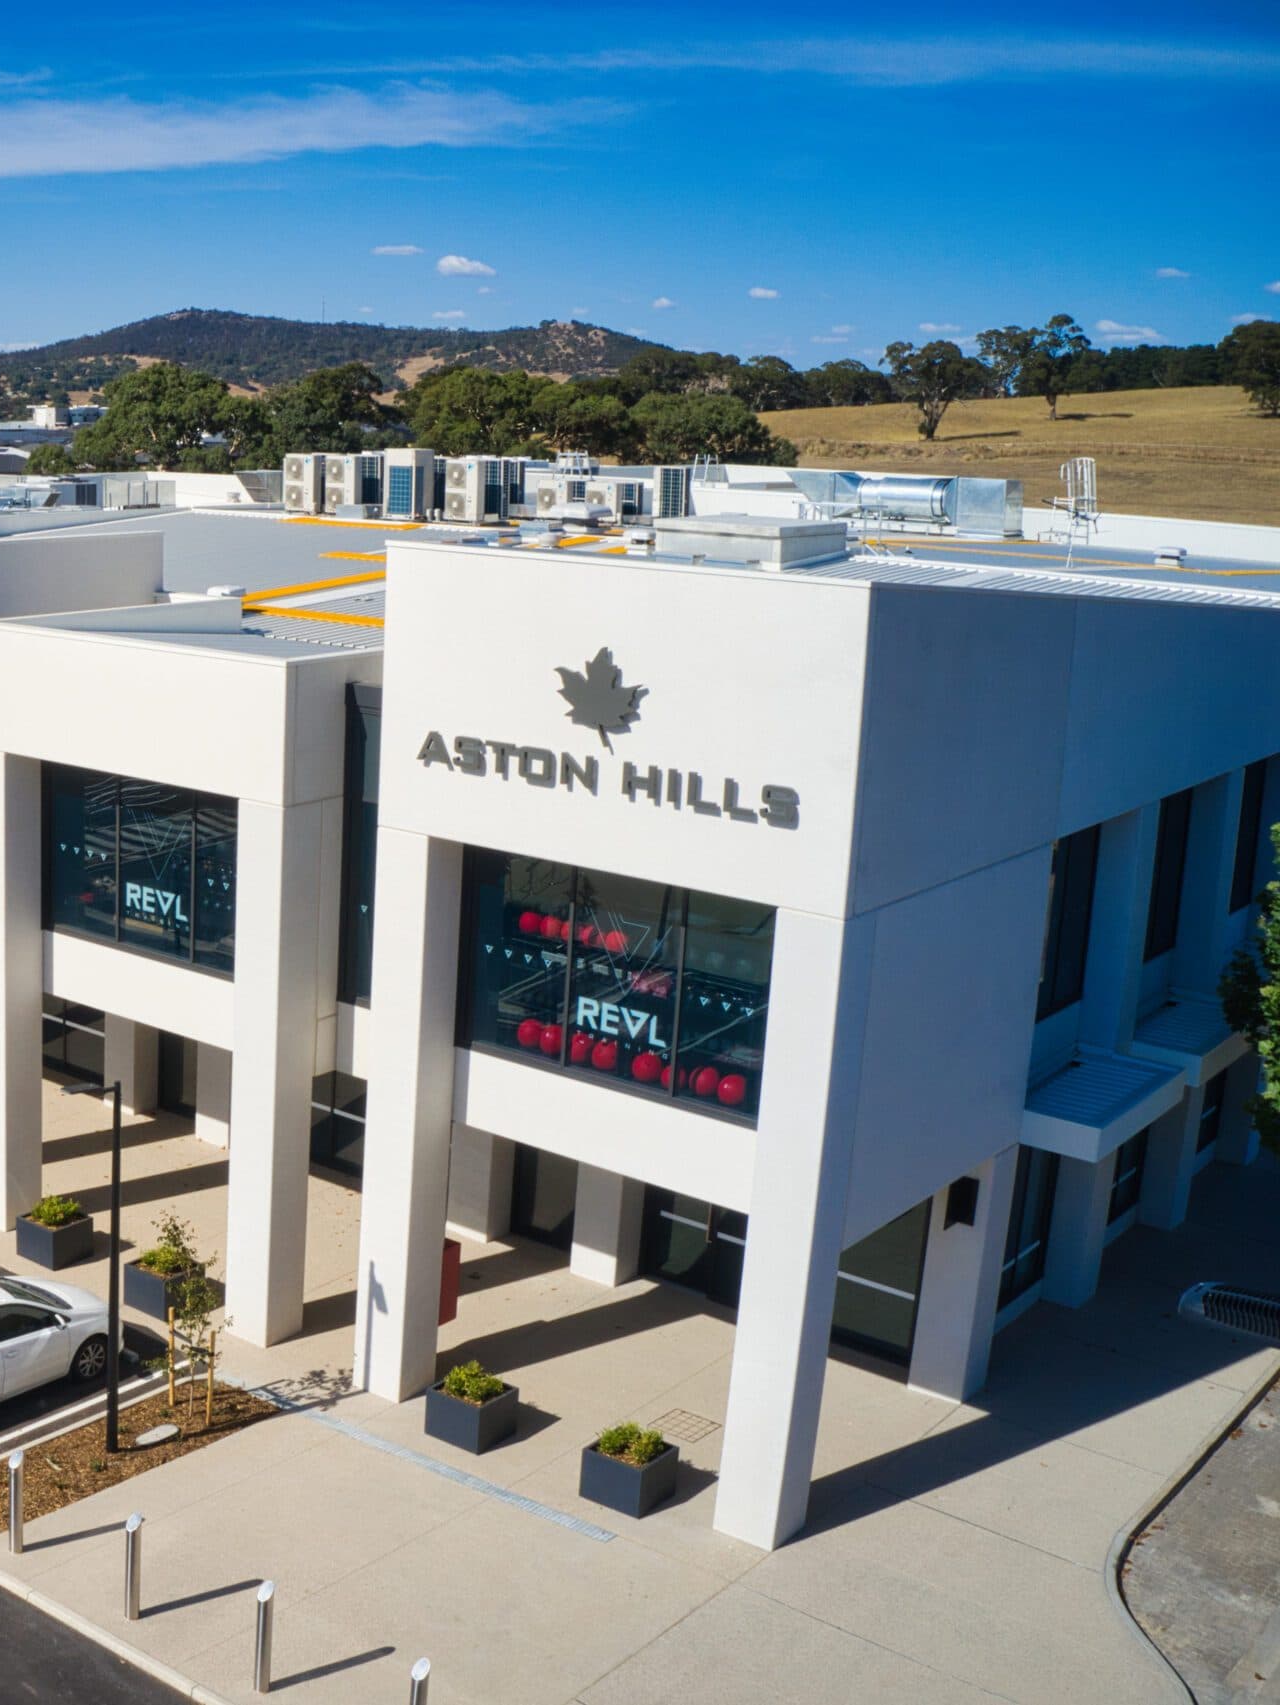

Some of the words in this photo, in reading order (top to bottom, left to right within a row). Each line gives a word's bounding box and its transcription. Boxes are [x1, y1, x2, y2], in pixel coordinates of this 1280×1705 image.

[417, 731, 598, 796] ASTON
[622, 761, 799, 830] HILLS
[126, 882, 188, 922] REVL
[577, 996, 667, 1048] REVL
